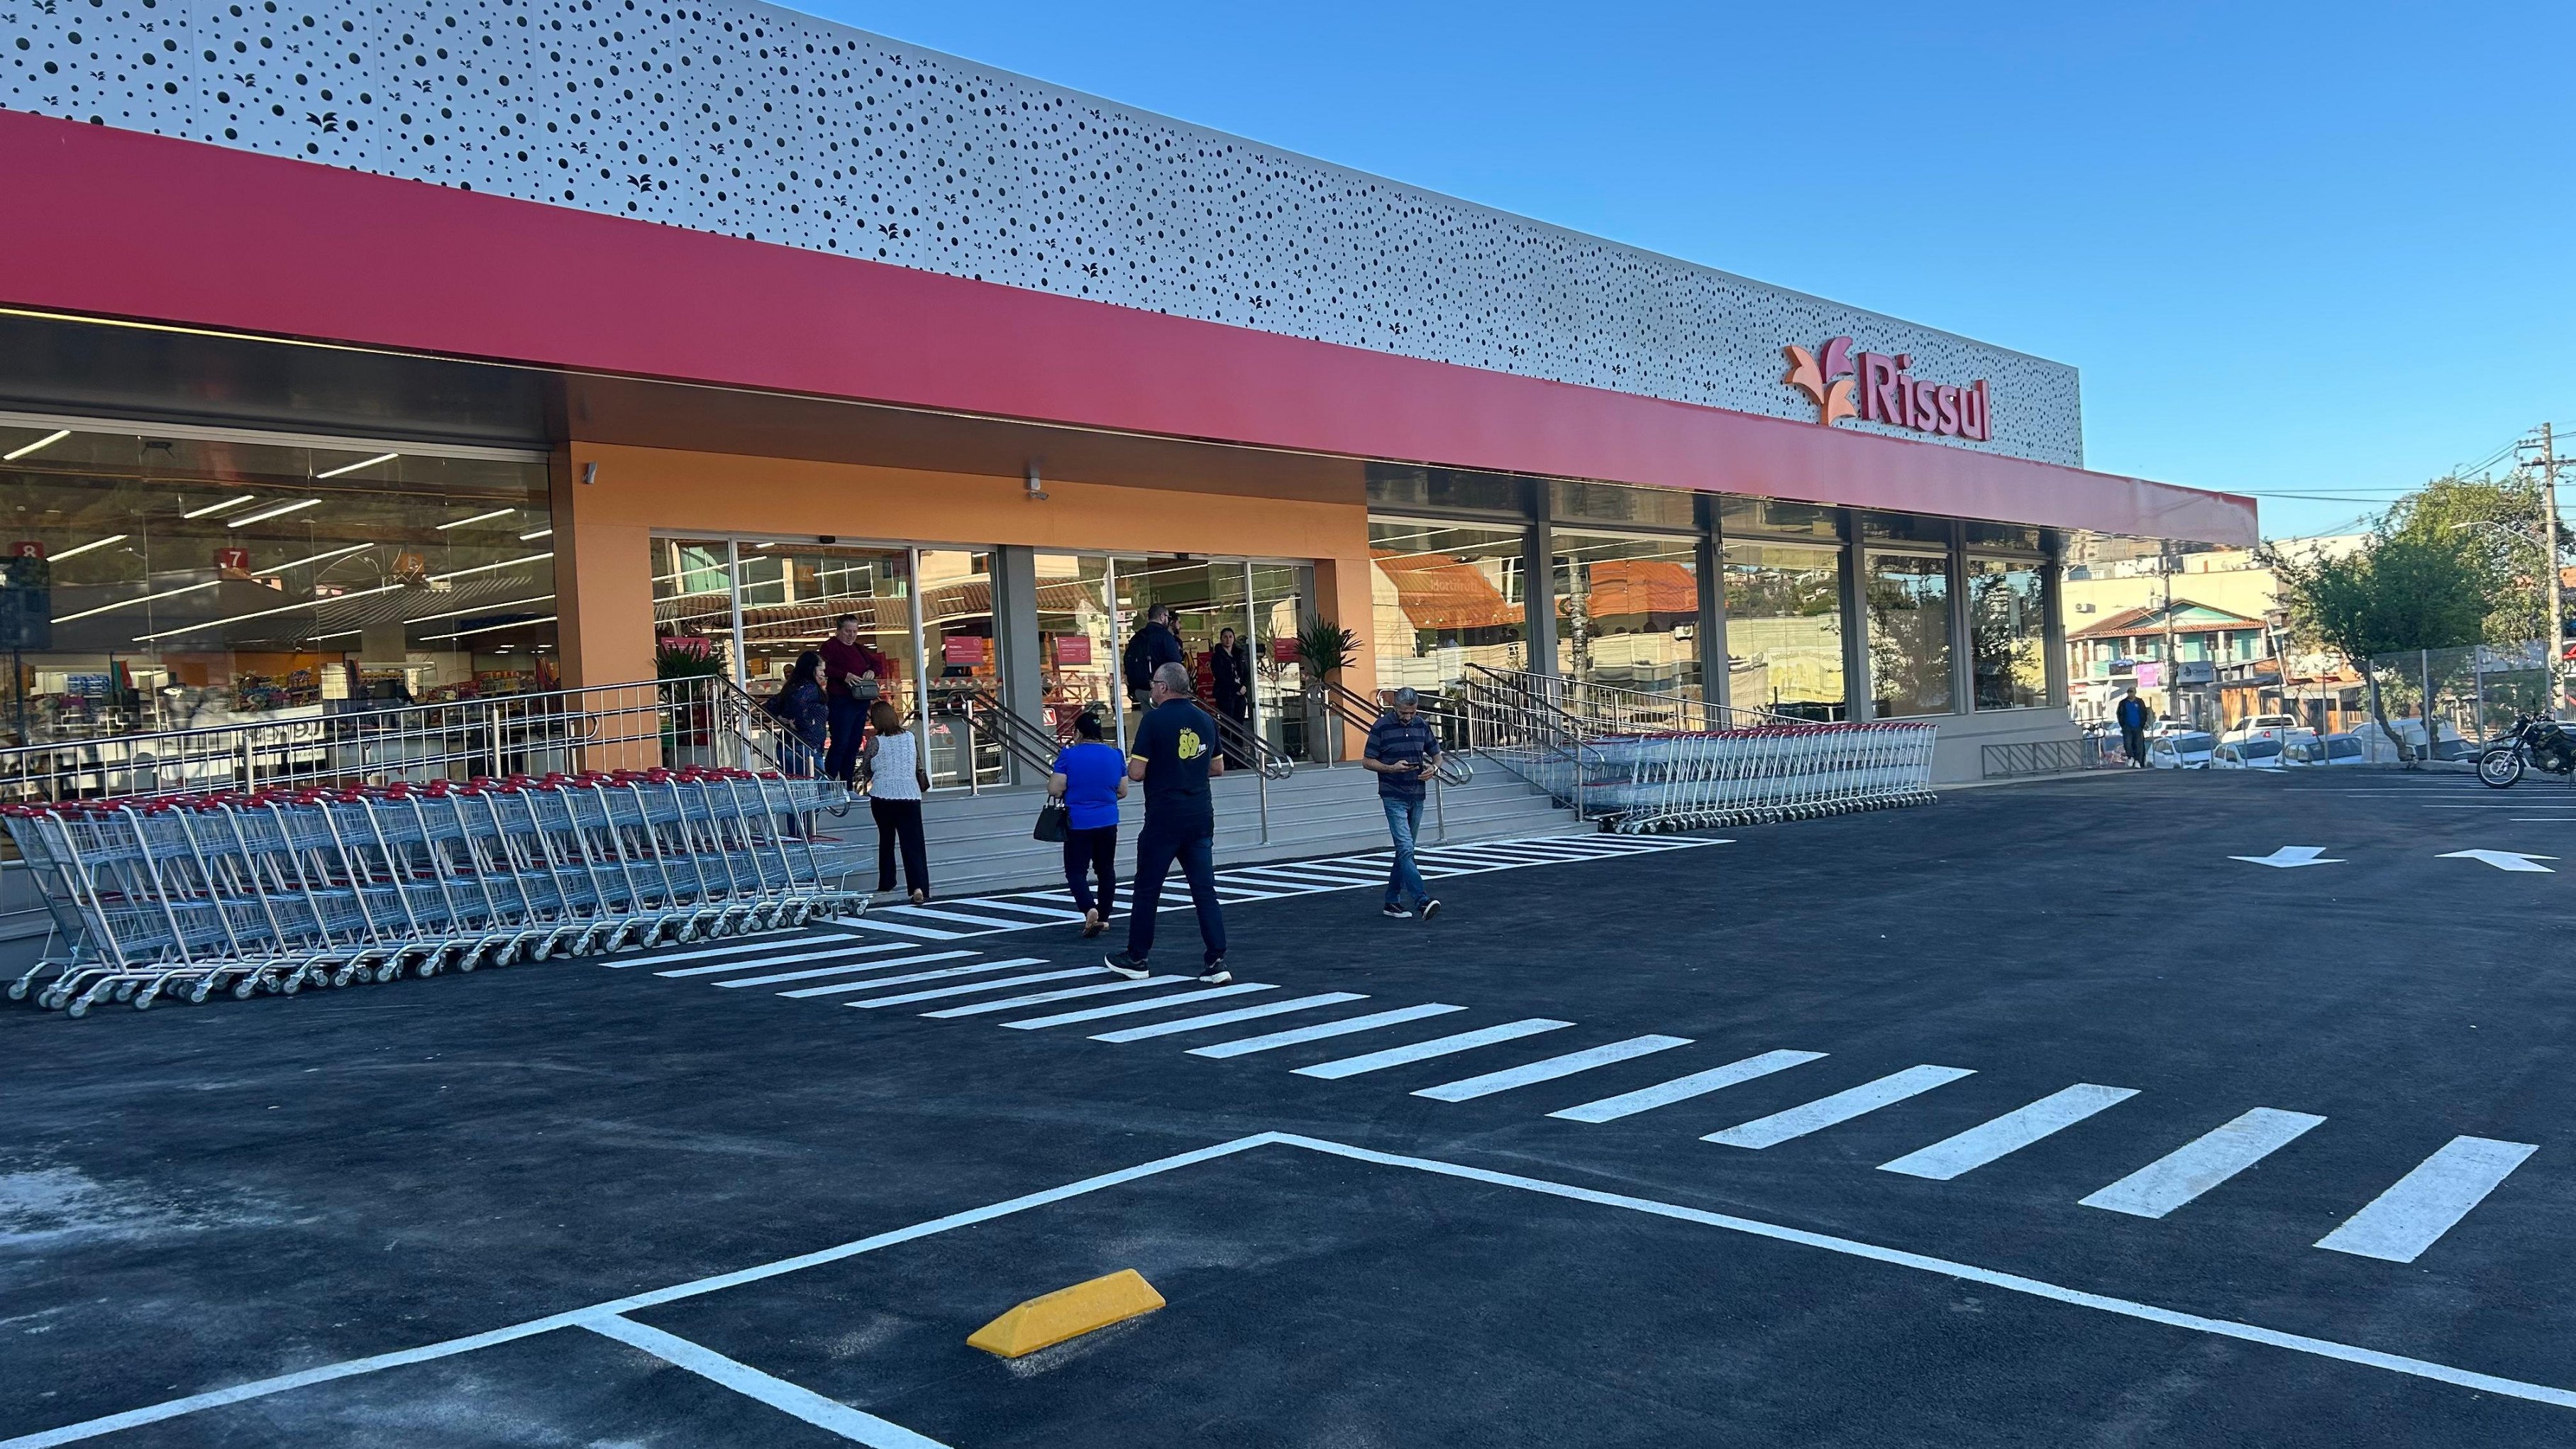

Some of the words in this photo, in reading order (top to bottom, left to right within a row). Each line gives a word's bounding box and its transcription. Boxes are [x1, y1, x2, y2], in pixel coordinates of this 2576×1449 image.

[1857, 351, 1993, 441] Rissul
[229, 551, 241, 566] 7
[1178, 732, 1200, 759] 89
